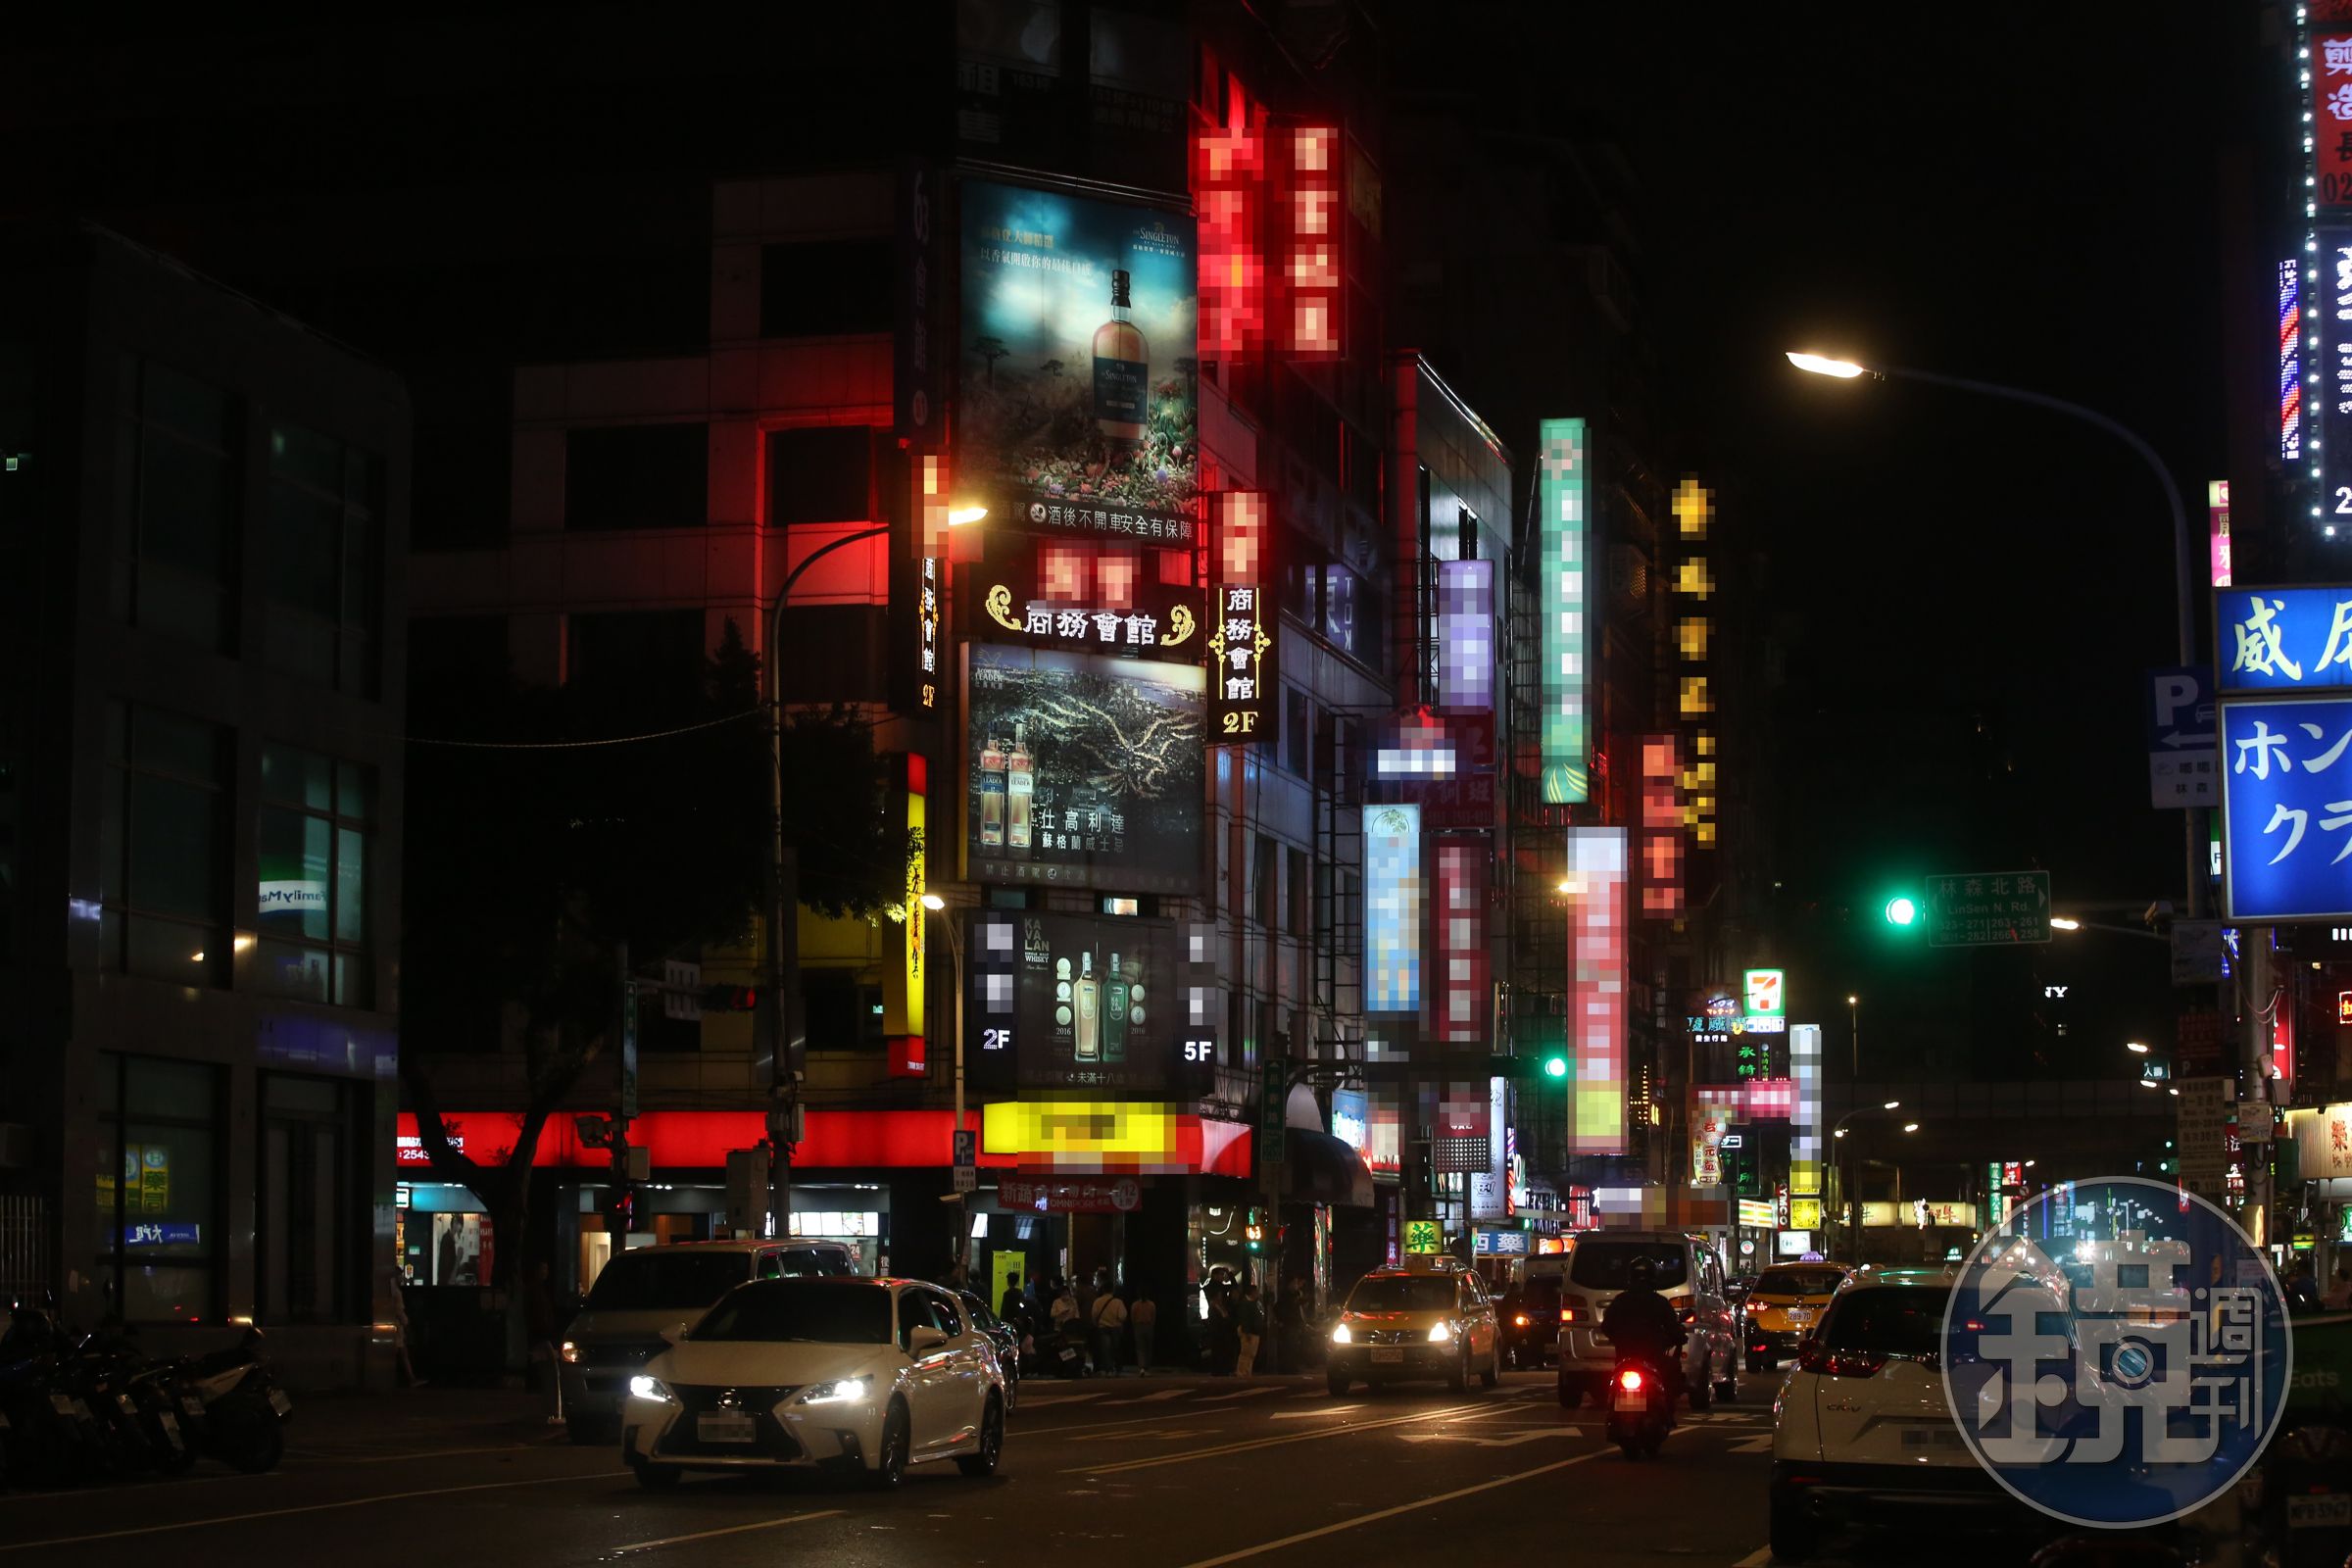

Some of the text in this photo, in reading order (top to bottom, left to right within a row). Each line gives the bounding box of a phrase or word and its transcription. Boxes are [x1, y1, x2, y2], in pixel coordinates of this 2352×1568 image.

[1048, 504, 1194, 540] 酒後不開車安全有保障
[1227, 588, 1254, 701] 商務會館
[2155, 675, 2199, 726] P
[1223, 711, 1258, 734] 2F
[1939, 876, 2036, 899] 林森北路
[2011, 901, 2032, 912] Rd.
[1025, 956, 1050, 964] WHISKY
[983, 1030, 1010, 1050] 2F
[1184, 1040, 1212, 1062] 5F
[1406, 1222, 1442, 1253] 藥
